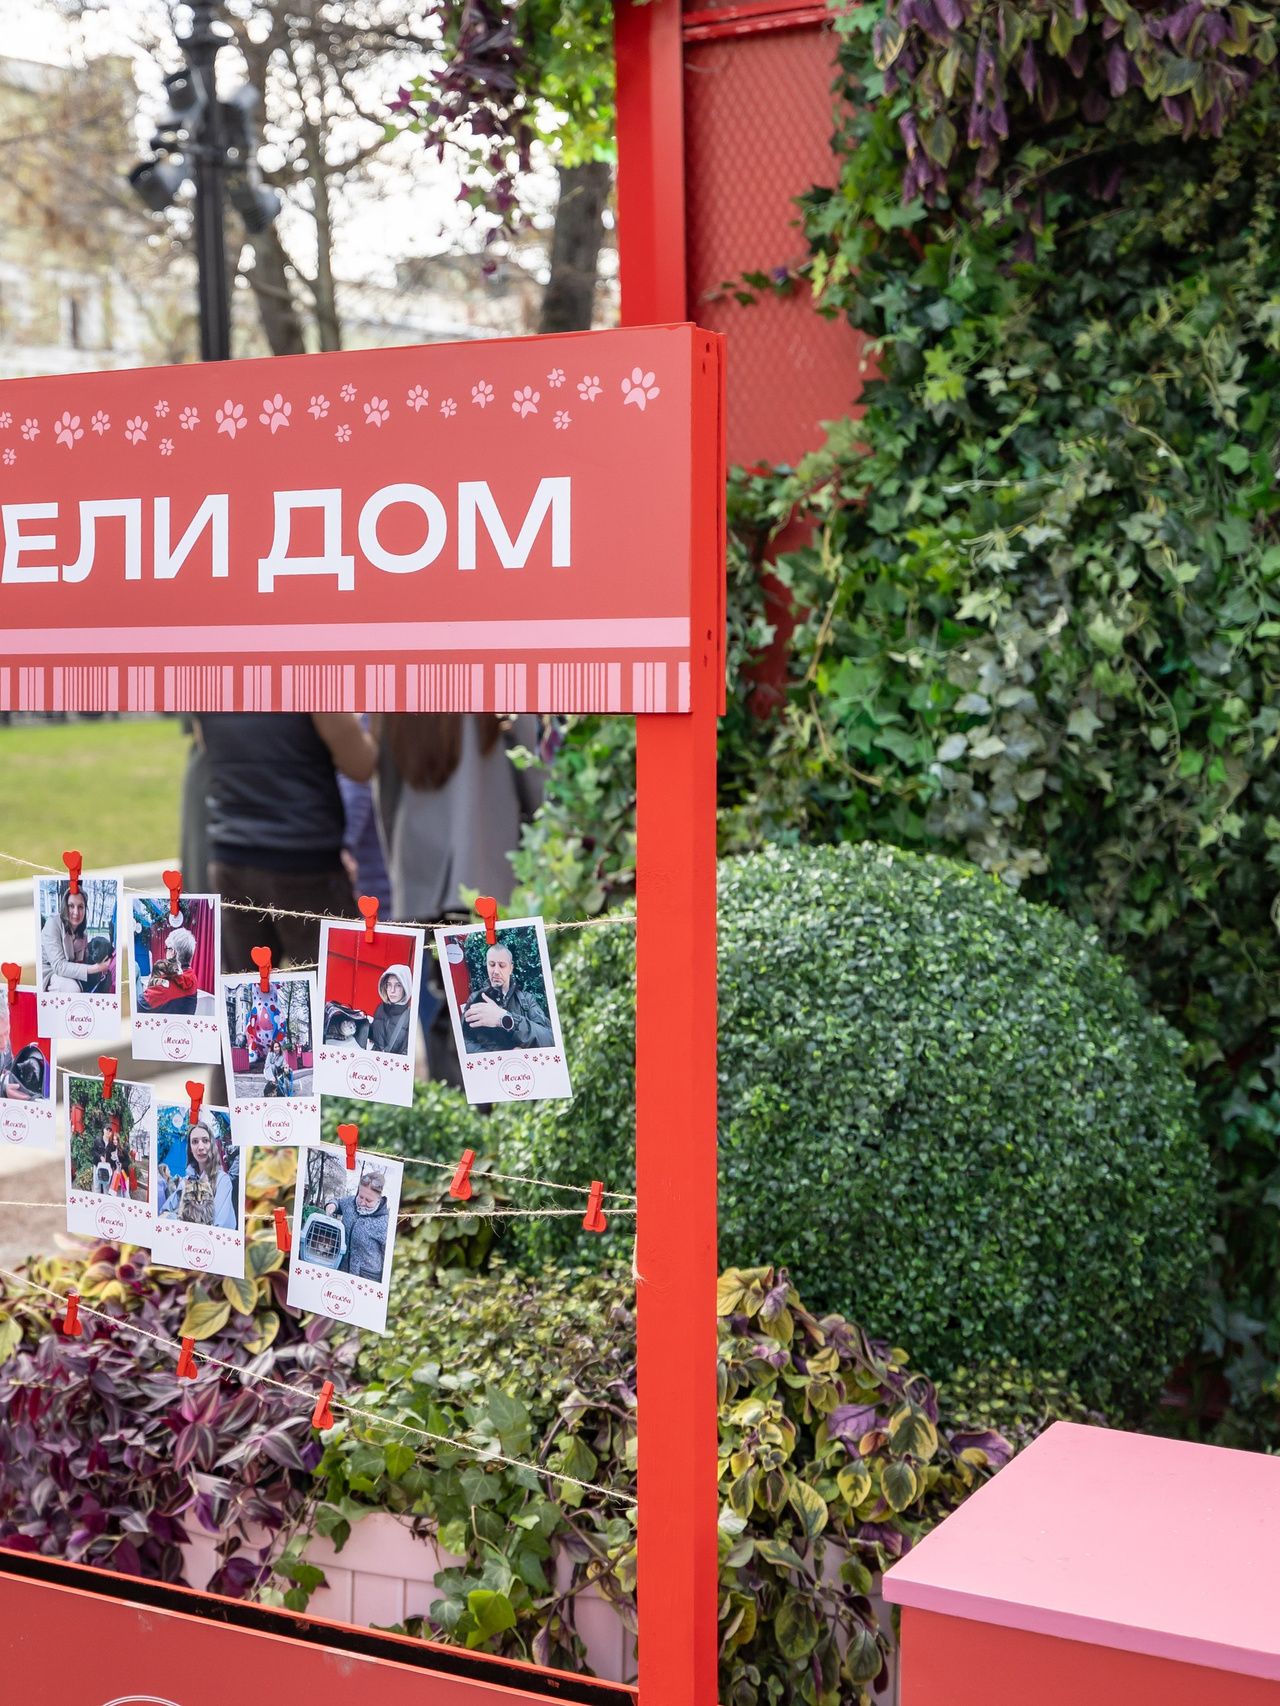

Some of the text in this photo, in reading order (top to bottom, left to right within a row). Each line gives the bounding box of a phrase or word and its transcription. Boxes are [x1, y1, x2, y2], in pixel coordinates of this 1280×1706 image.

[257, 477, 572, 593] ДОМ
[67, 1014, 92, 1023] Москва
[164, 1035, 190, 1046] Москва
[349, 1071, 378, 1083] Москва
[501, 1071, 531, 1084] Москва
[2, 1119, 27, 1129] Москва
[264, 1119, 291, 1129] Москва
[98, 1215, 124, 1228] Москва
[184, 1244, 212, 1256] Москва
[323, 1290, 352, 1303] Москва
